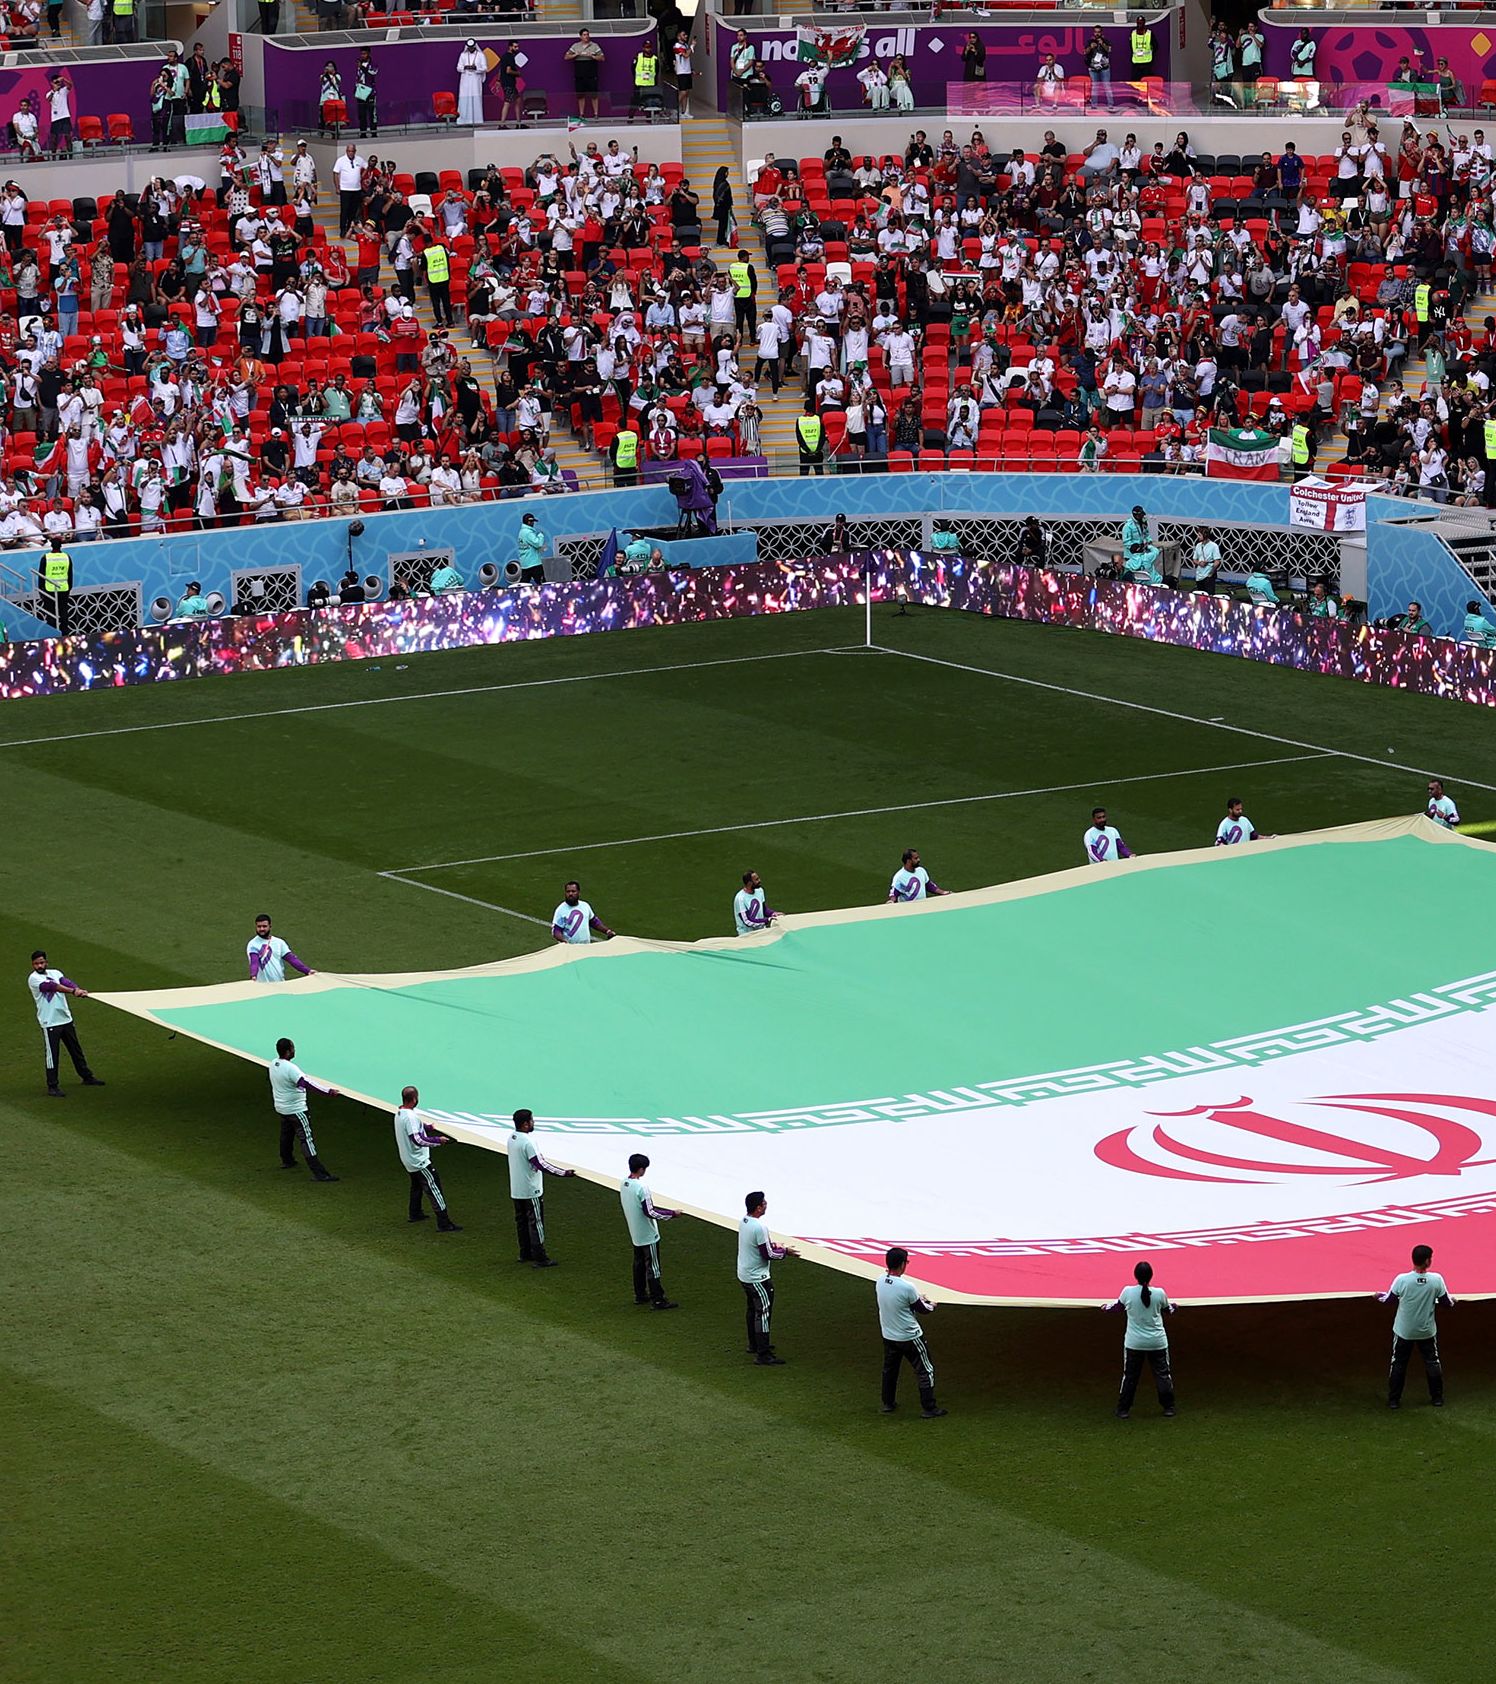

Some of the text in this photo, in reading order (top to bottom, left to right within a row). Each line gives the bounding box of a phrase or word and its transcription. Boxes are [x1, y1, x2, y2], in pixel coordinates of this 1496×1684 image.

[875, 27, 916, 58] all
[1224, 448, 1266, 466] IRAN
[1292, 486, 1365, 503] Colchester United
[1295, 507, 1320, 518] England
[1298, 516, 1315, 526] Away
